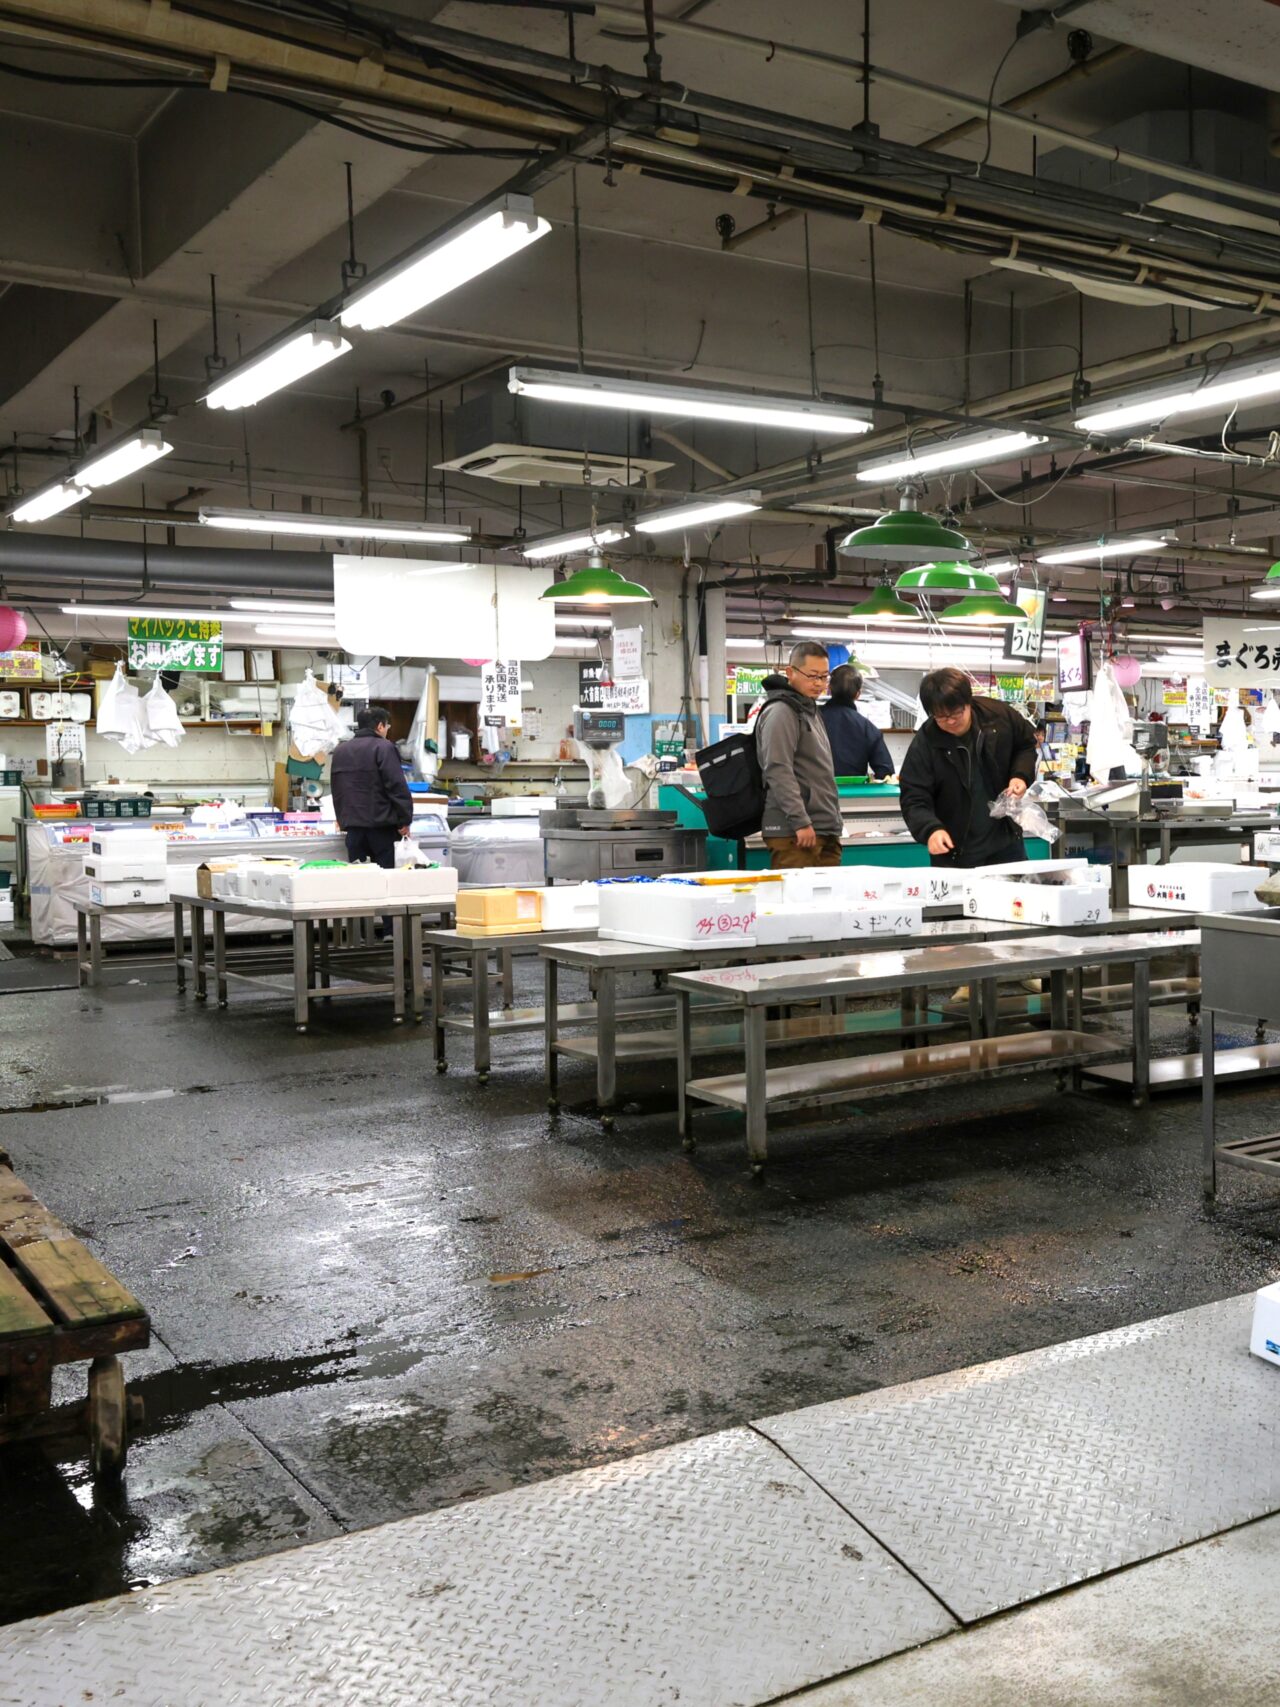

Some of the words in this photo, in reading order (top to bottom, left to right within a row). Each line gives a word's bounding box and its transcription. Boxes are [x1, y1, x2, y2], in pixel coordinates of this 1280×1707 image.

[1013, 629, 1039, 651] うに
[1060, 666, 1082, 683] まぐろ
[485, 675, 496, 713] 承ります
